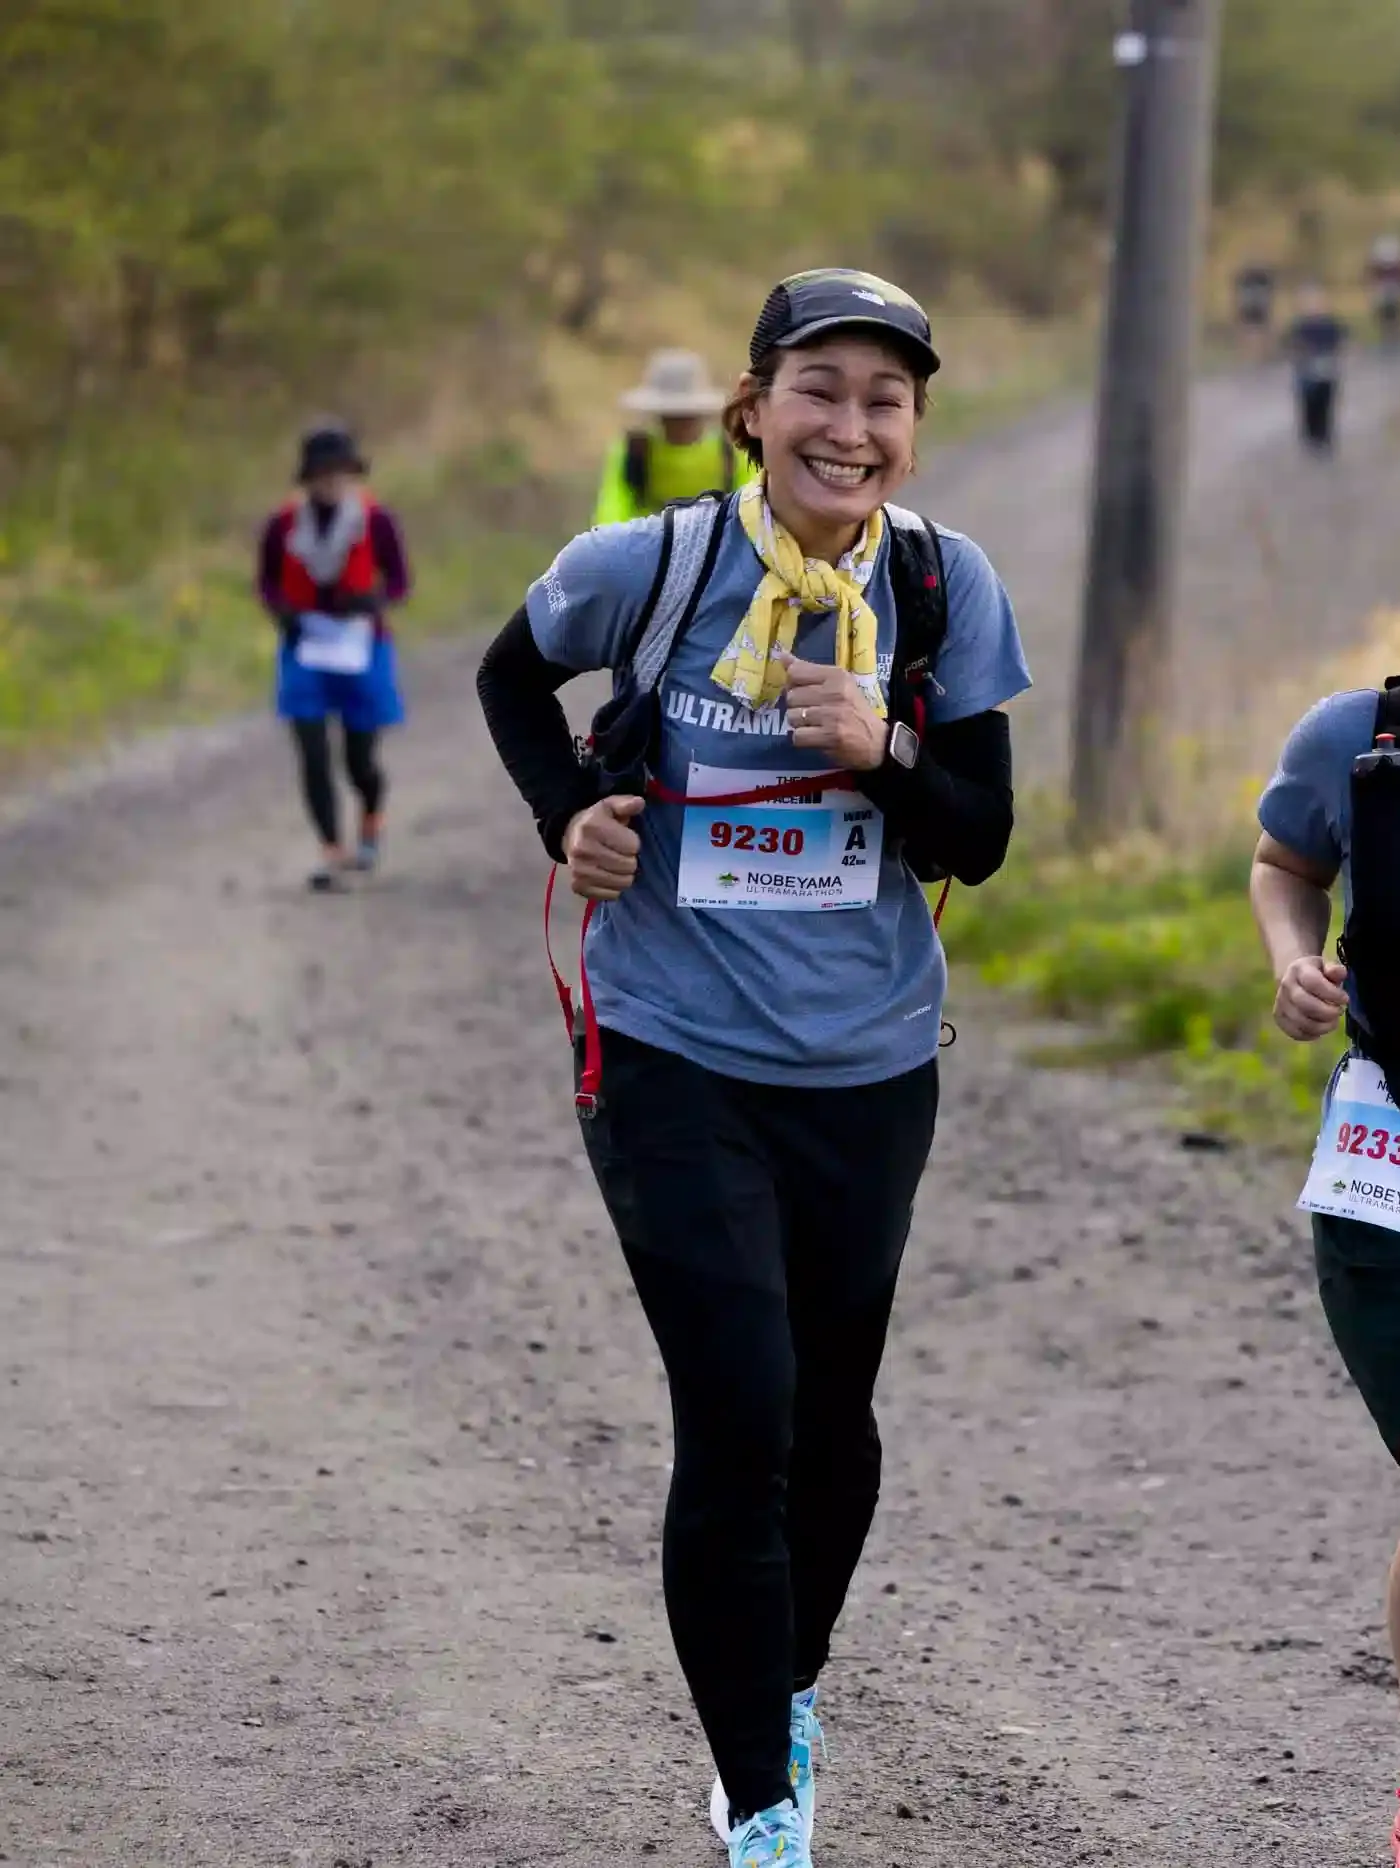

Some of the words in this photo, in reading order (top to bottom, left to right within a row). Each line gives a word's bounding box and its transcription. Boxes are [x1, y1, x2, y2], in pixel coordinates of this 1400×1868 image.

[710, 821, 804, 855] 9230
[844, 825, 866, 851] A
[746, 884, 843, 897] ULTRAMARATHON
[747, 872, 842, 889] NOBEYAMA
